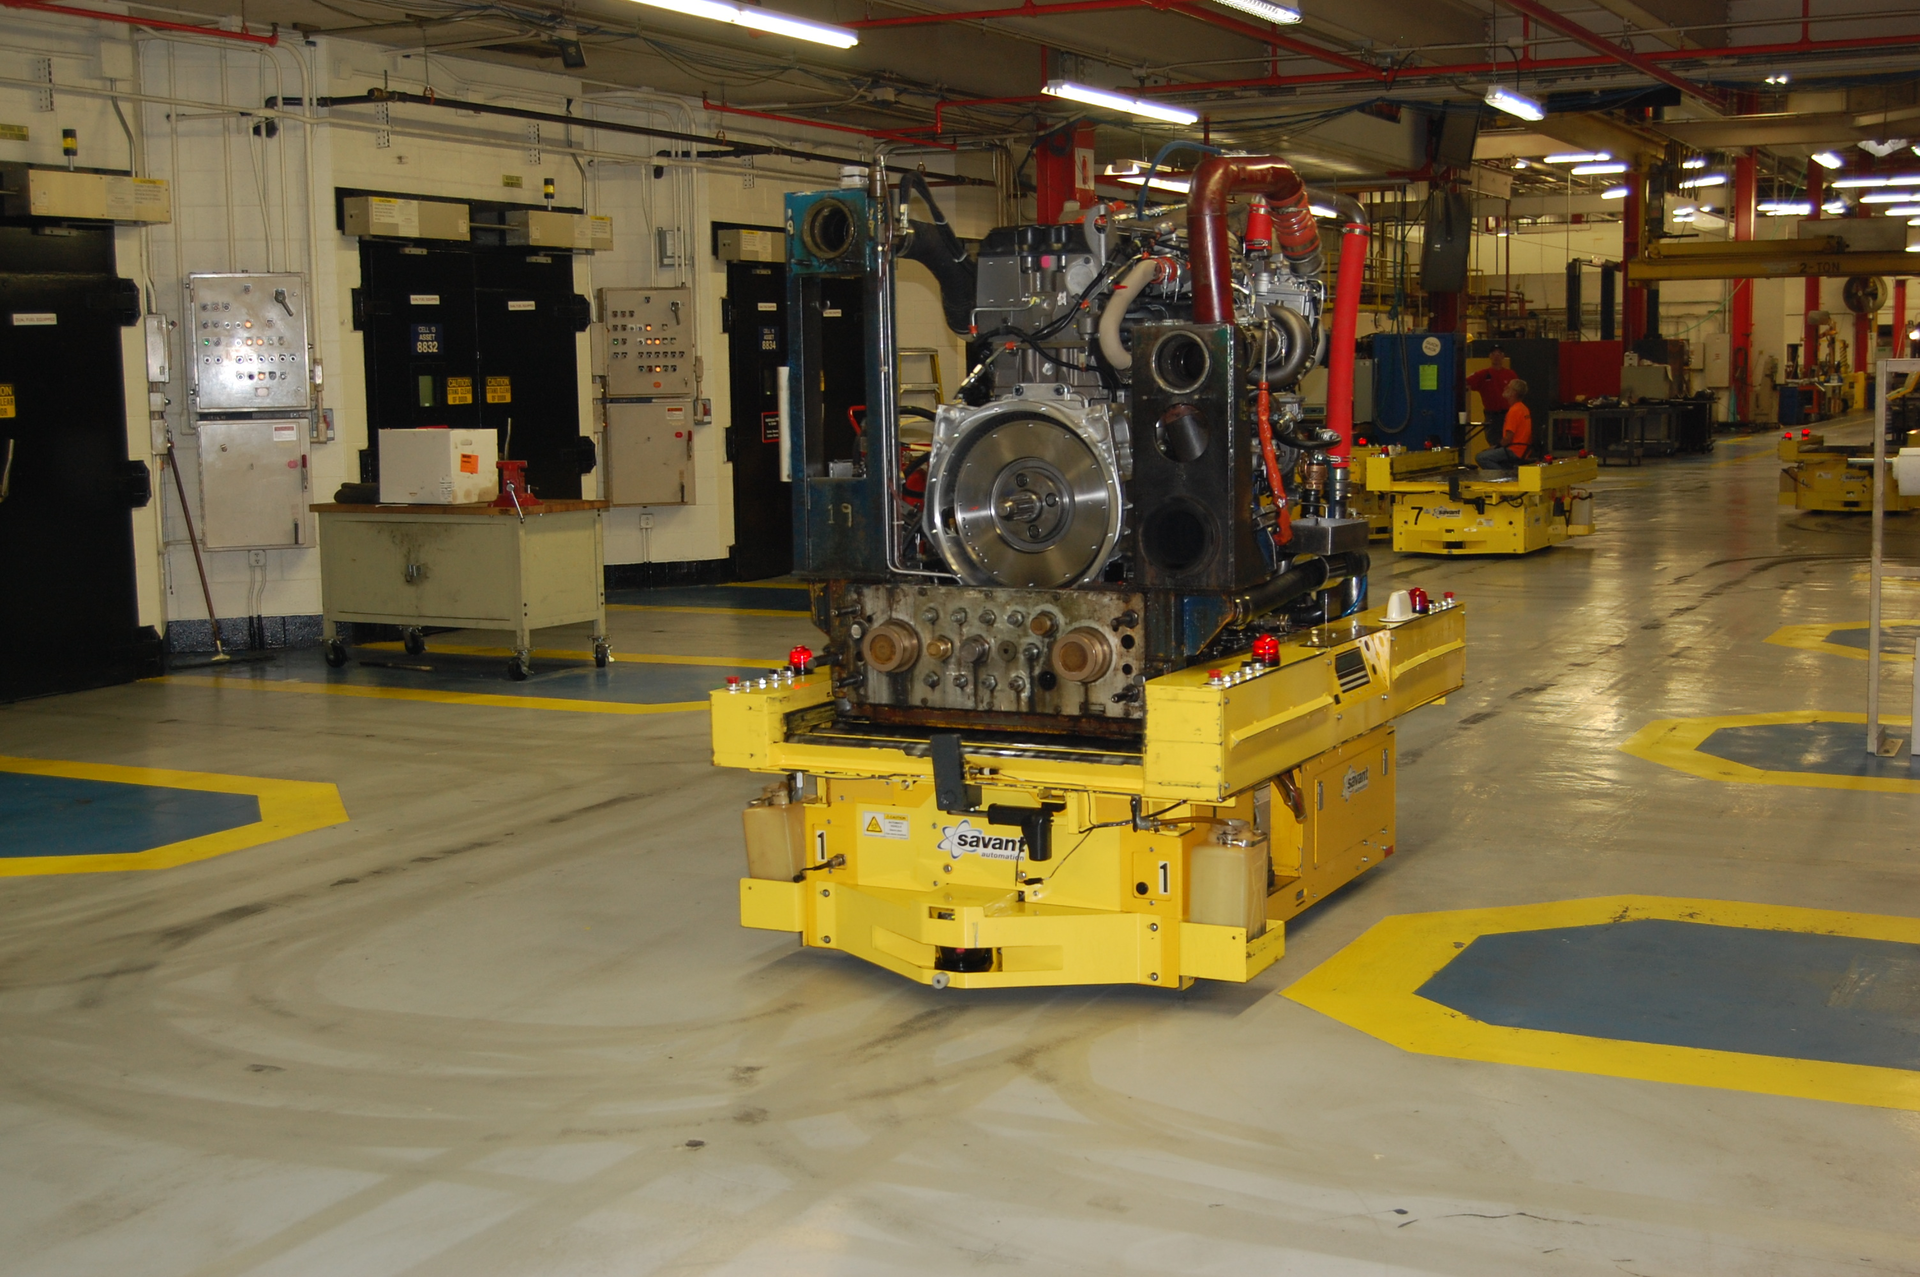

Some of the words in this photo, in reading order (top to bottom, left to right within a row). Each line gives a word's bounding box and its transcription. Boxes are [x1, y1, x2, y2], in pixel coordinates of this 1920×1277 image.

[417, 341, 438, 353] 8832
[762, 340, 776, 350] 8834
[449, 379, 471, 387] CAUTION
[487, 378, 510, 386] CAUTION
[1410, 506, 1424, 525] 7
[1347, 766, 1369, 789] savant
[817, 831, 826, 860] 1
[957, 834, 1027, 853] savant
[980, 852, 1025, 862] automation
[1159, 862, 1169, 893] 1
